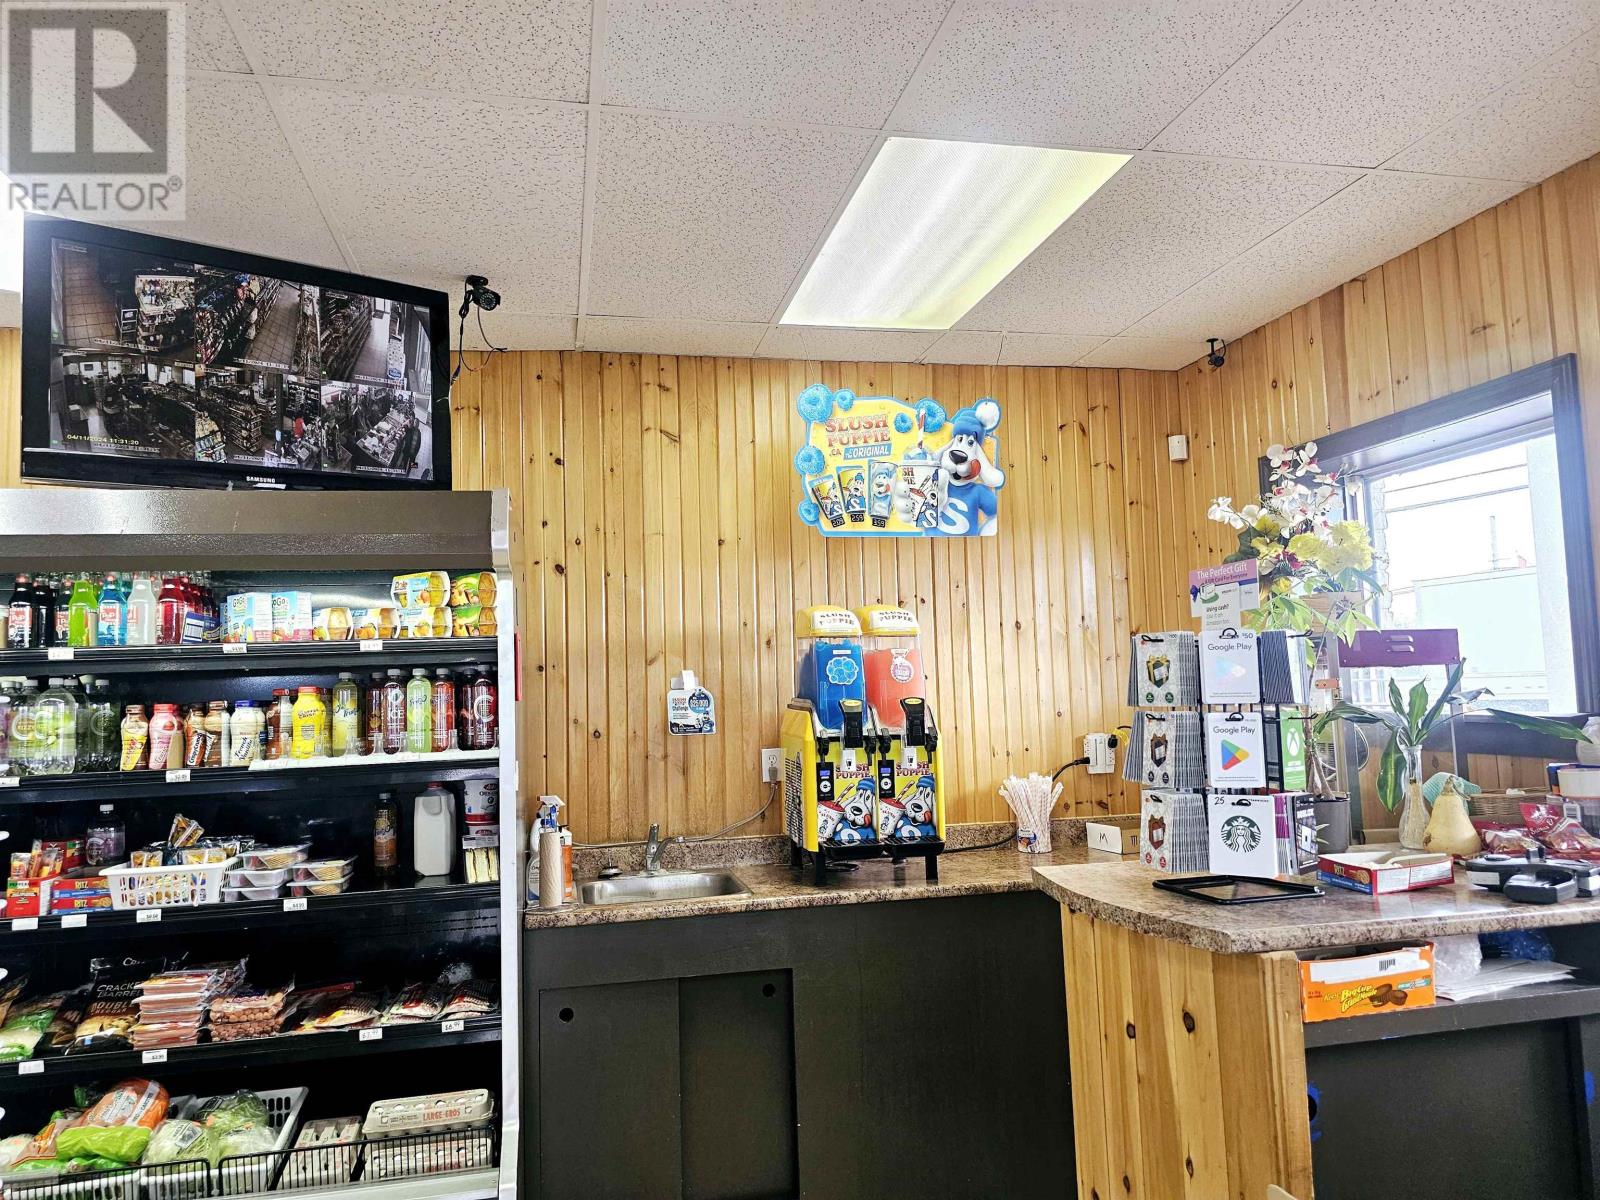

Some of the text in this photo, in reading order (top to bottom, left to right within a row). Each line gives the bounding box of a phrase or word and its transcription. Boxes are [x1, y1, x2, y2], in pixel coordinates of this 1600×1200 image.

[825, 414, 889, 433] SLUSH
[827, 431, 891, 447] PUPPIE
[852, 445, 890, 458] ORIGINAL
[1197, 561, 1248, 579] The Perfect Gift
[1207, 642, 1252, 652] Google Play
[1213, 725, 1255, 736] Google Play
[835, 771, 870, 780] PUPPIE
[896, 768, 931, 777] PUPPIE
[1214, 796, 1225, 806] 25
[75, 881, 89, 890] RITZ
[74, 899, 88, 909] RITZ
[97, 981, 141, 993] CRACKE
[423, 1110, 443, 1121] LARGE
